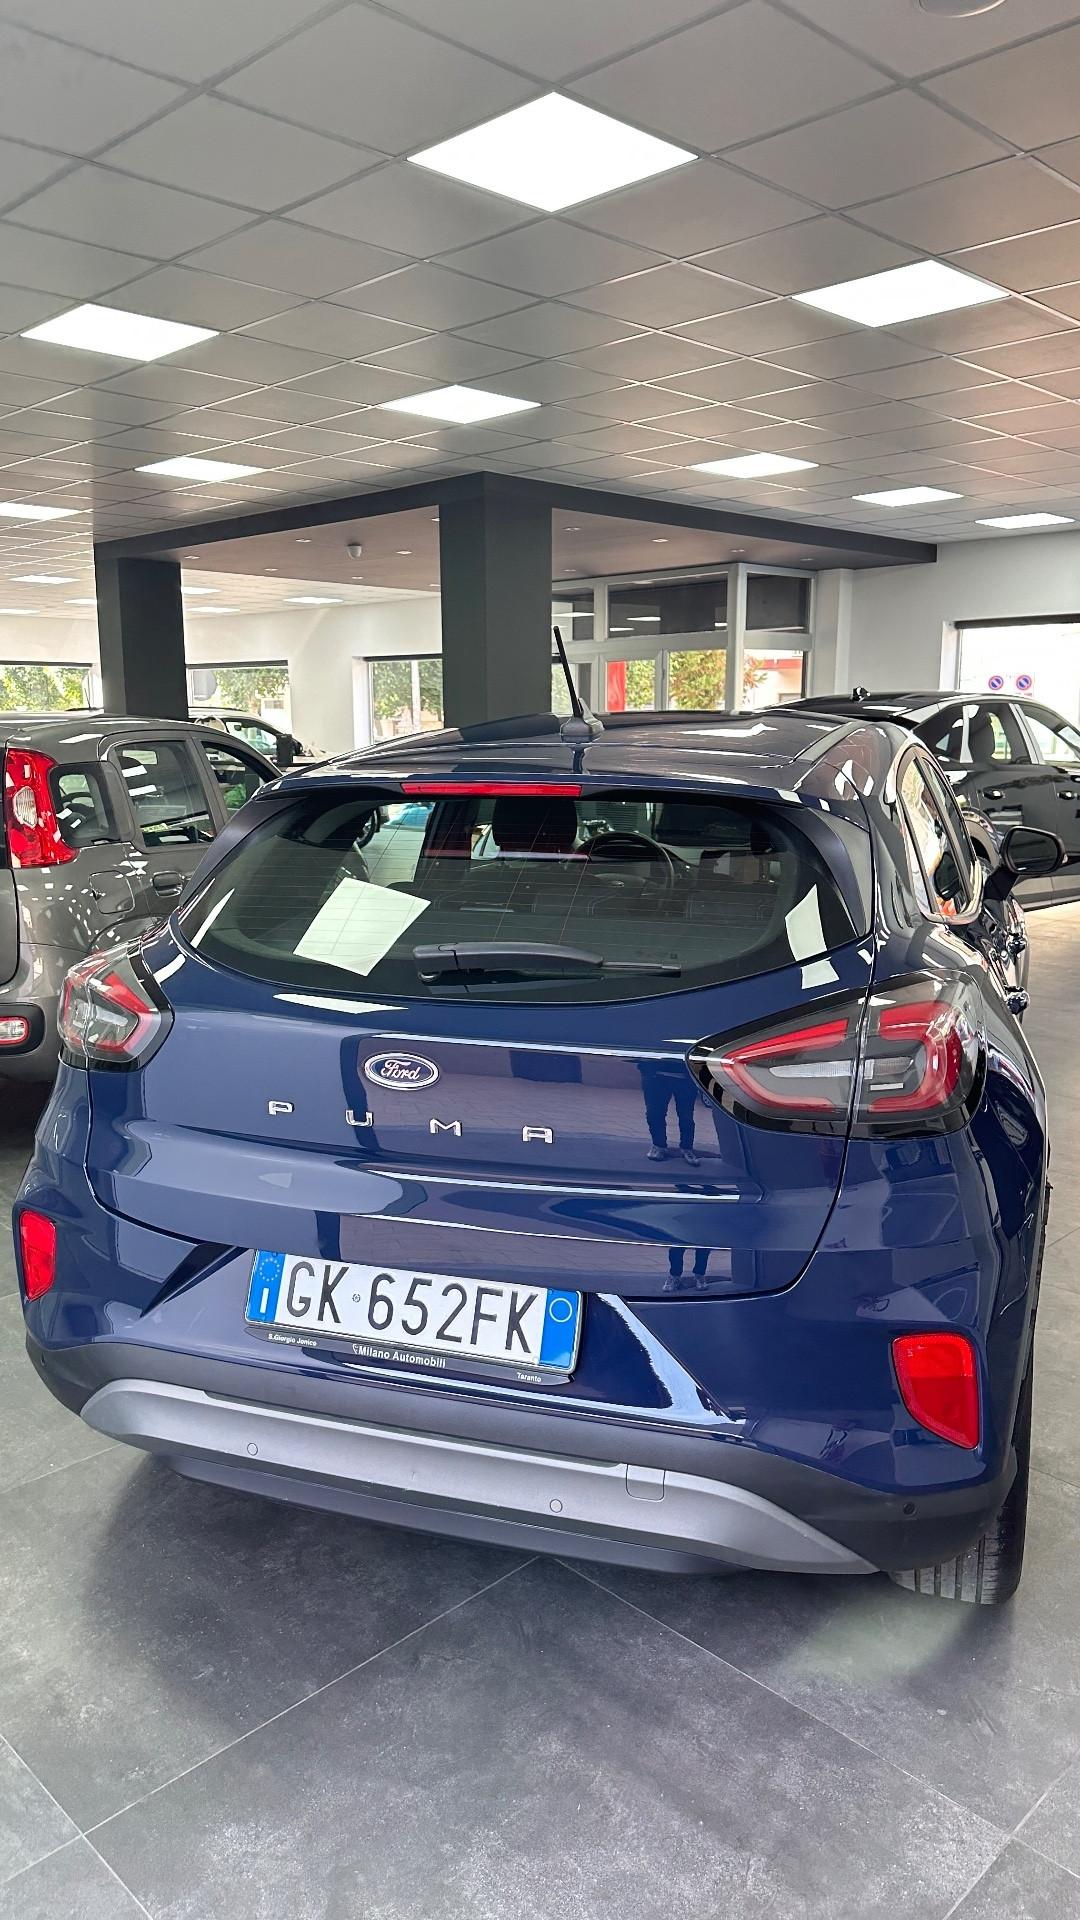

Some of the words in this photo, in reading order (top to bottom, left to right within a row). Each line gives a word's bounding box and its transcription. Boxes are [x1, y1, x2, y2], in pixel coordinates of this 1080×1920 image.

[380, 1059, 421, 1080] Ford
[268, 1100, 553, 1144] PUMA
[286, 1261, 350, 1324] GK
[366, 1272, 539, 1354] 652FK
[296, 1337, 318, 1347] Jonico
[358, 1345, 390, 1360] Milano
[392, 1350, 447, 1369] Automobili
[516, 1371, 542, 1383] Taranto
